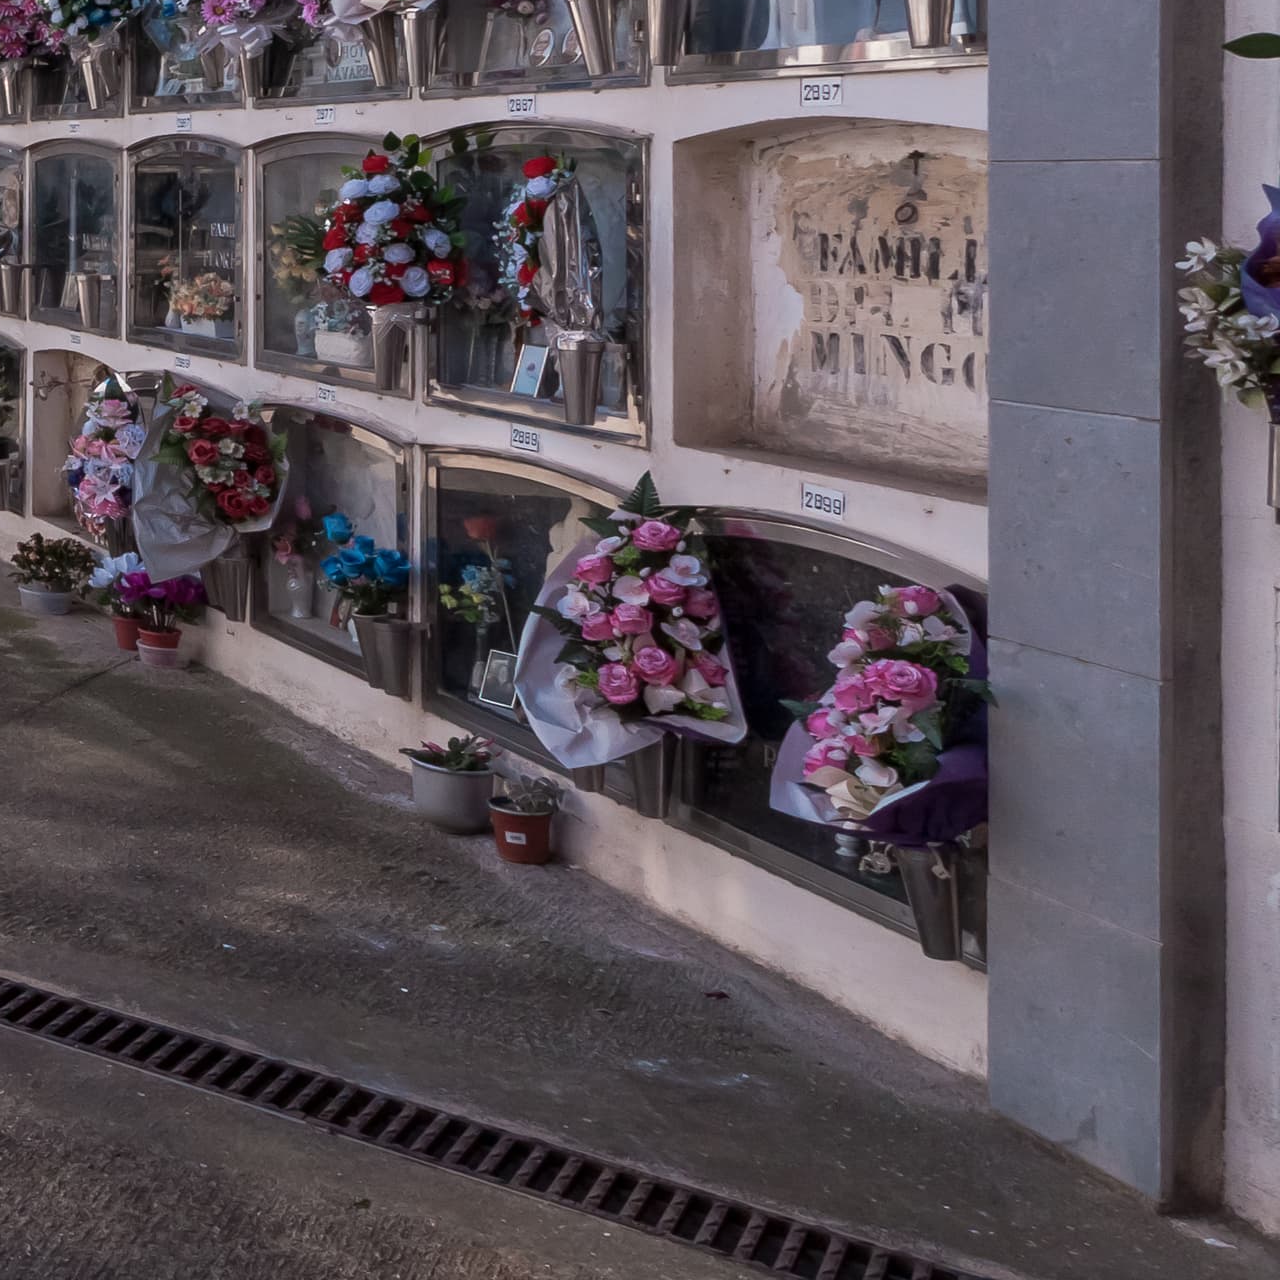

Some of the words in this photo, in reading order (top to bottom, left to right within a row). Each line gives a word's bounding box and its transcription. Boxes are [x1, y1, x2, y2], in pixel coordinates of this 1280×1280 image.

[803, 83, 841, 101] 2897
[509, 98, 534, 113] 2887
[817, 233, 988, 284] FAMILI
[804, 490, 842, 517] 2899
